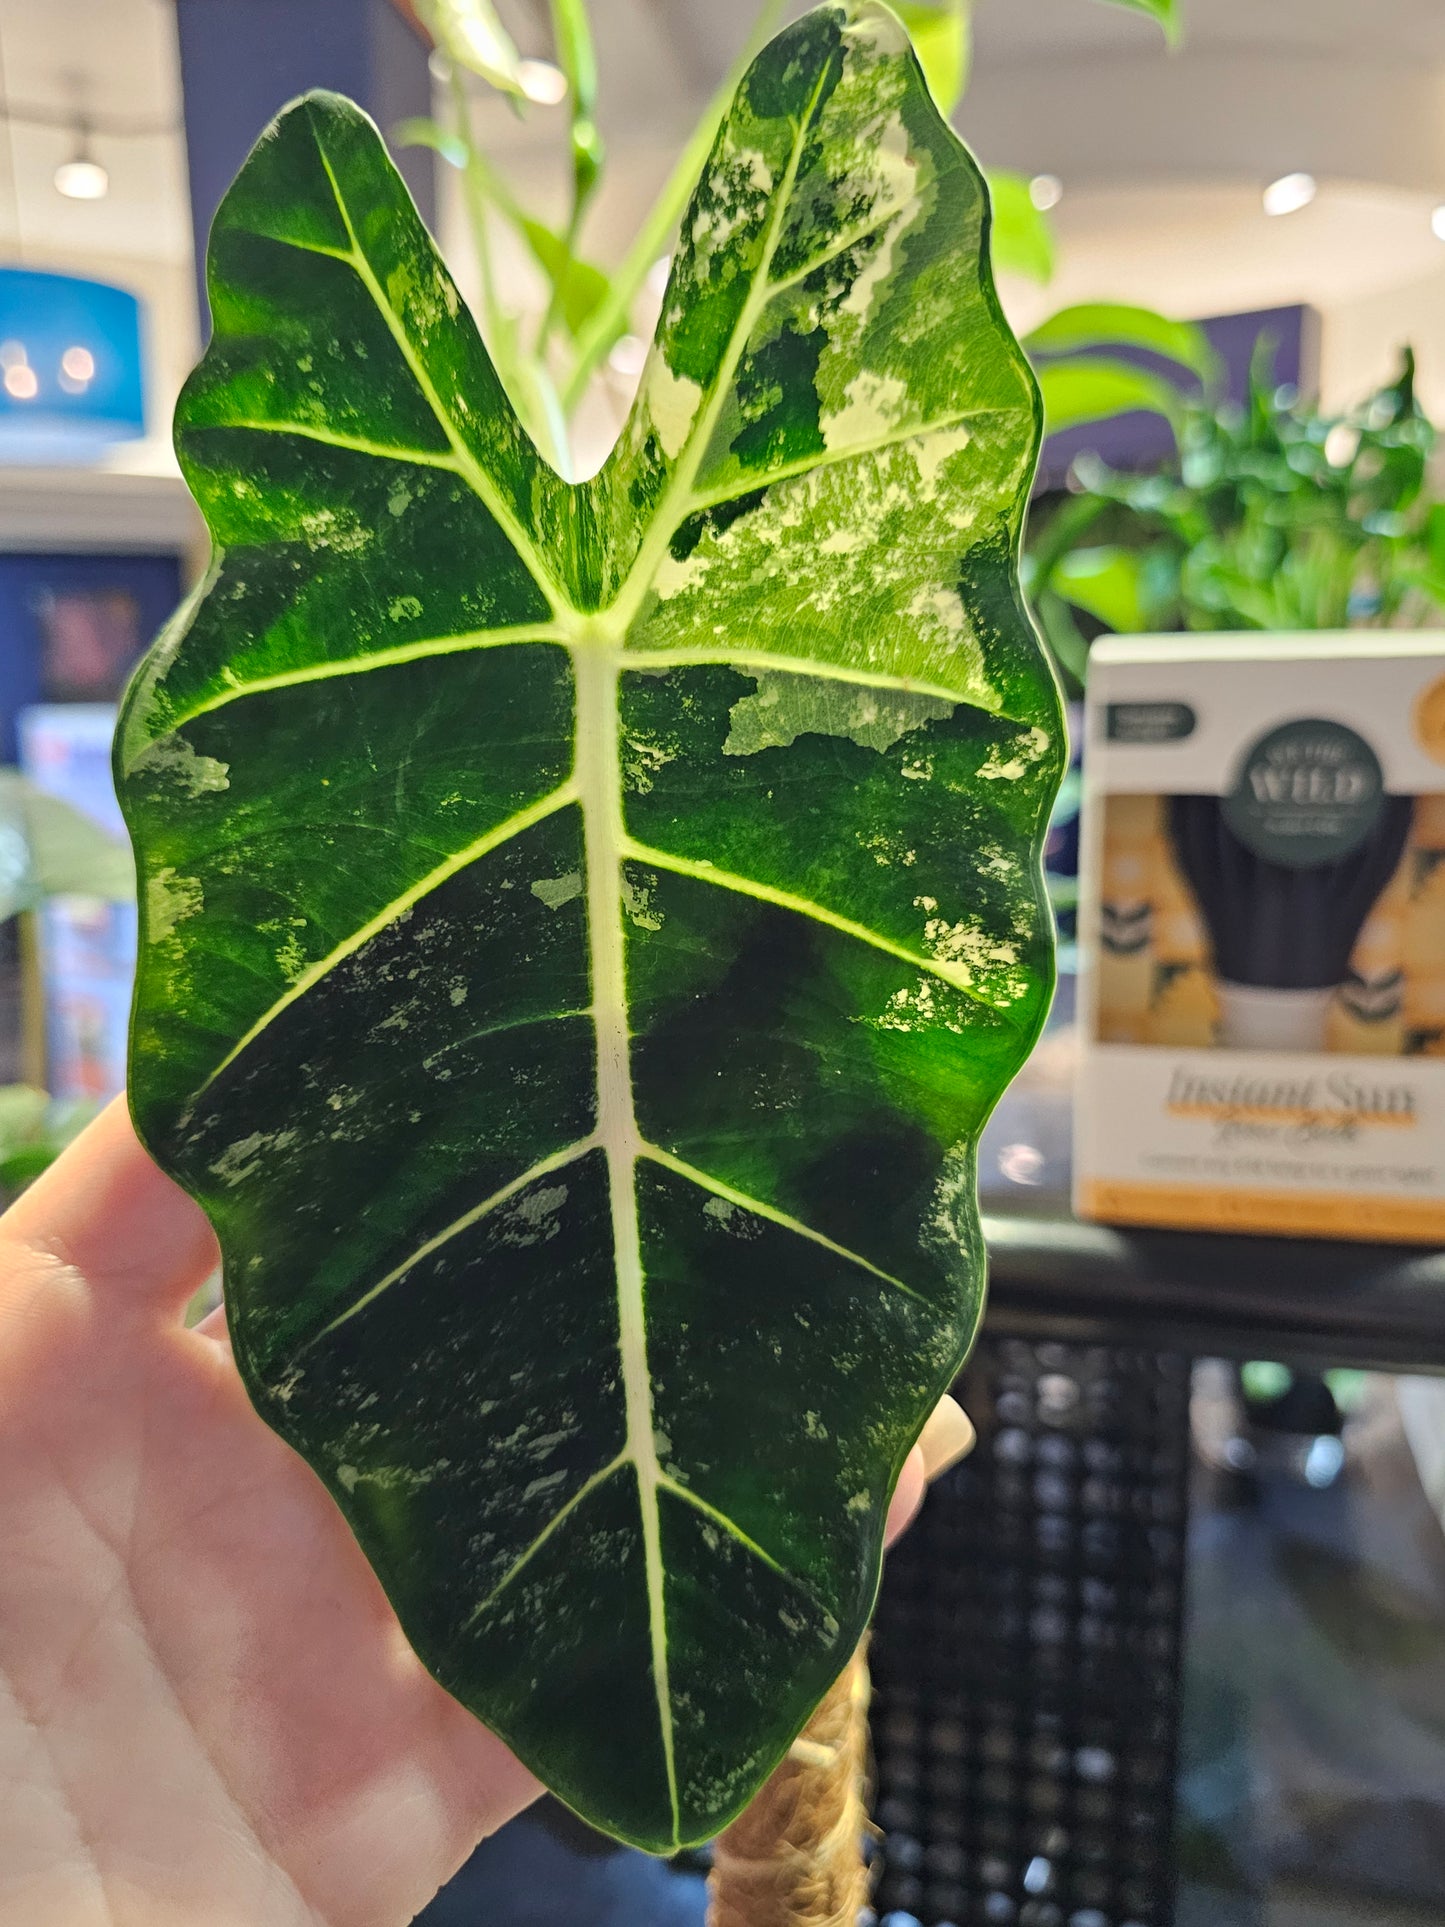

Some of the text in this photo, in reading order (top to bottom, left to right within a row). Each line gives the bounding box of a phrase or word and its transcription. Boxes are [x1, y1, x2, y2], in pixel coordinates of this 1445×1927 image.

[1249, 764, 1366, 803] WILD
[1166, 1064, 1416, 1115] Instant Sun
